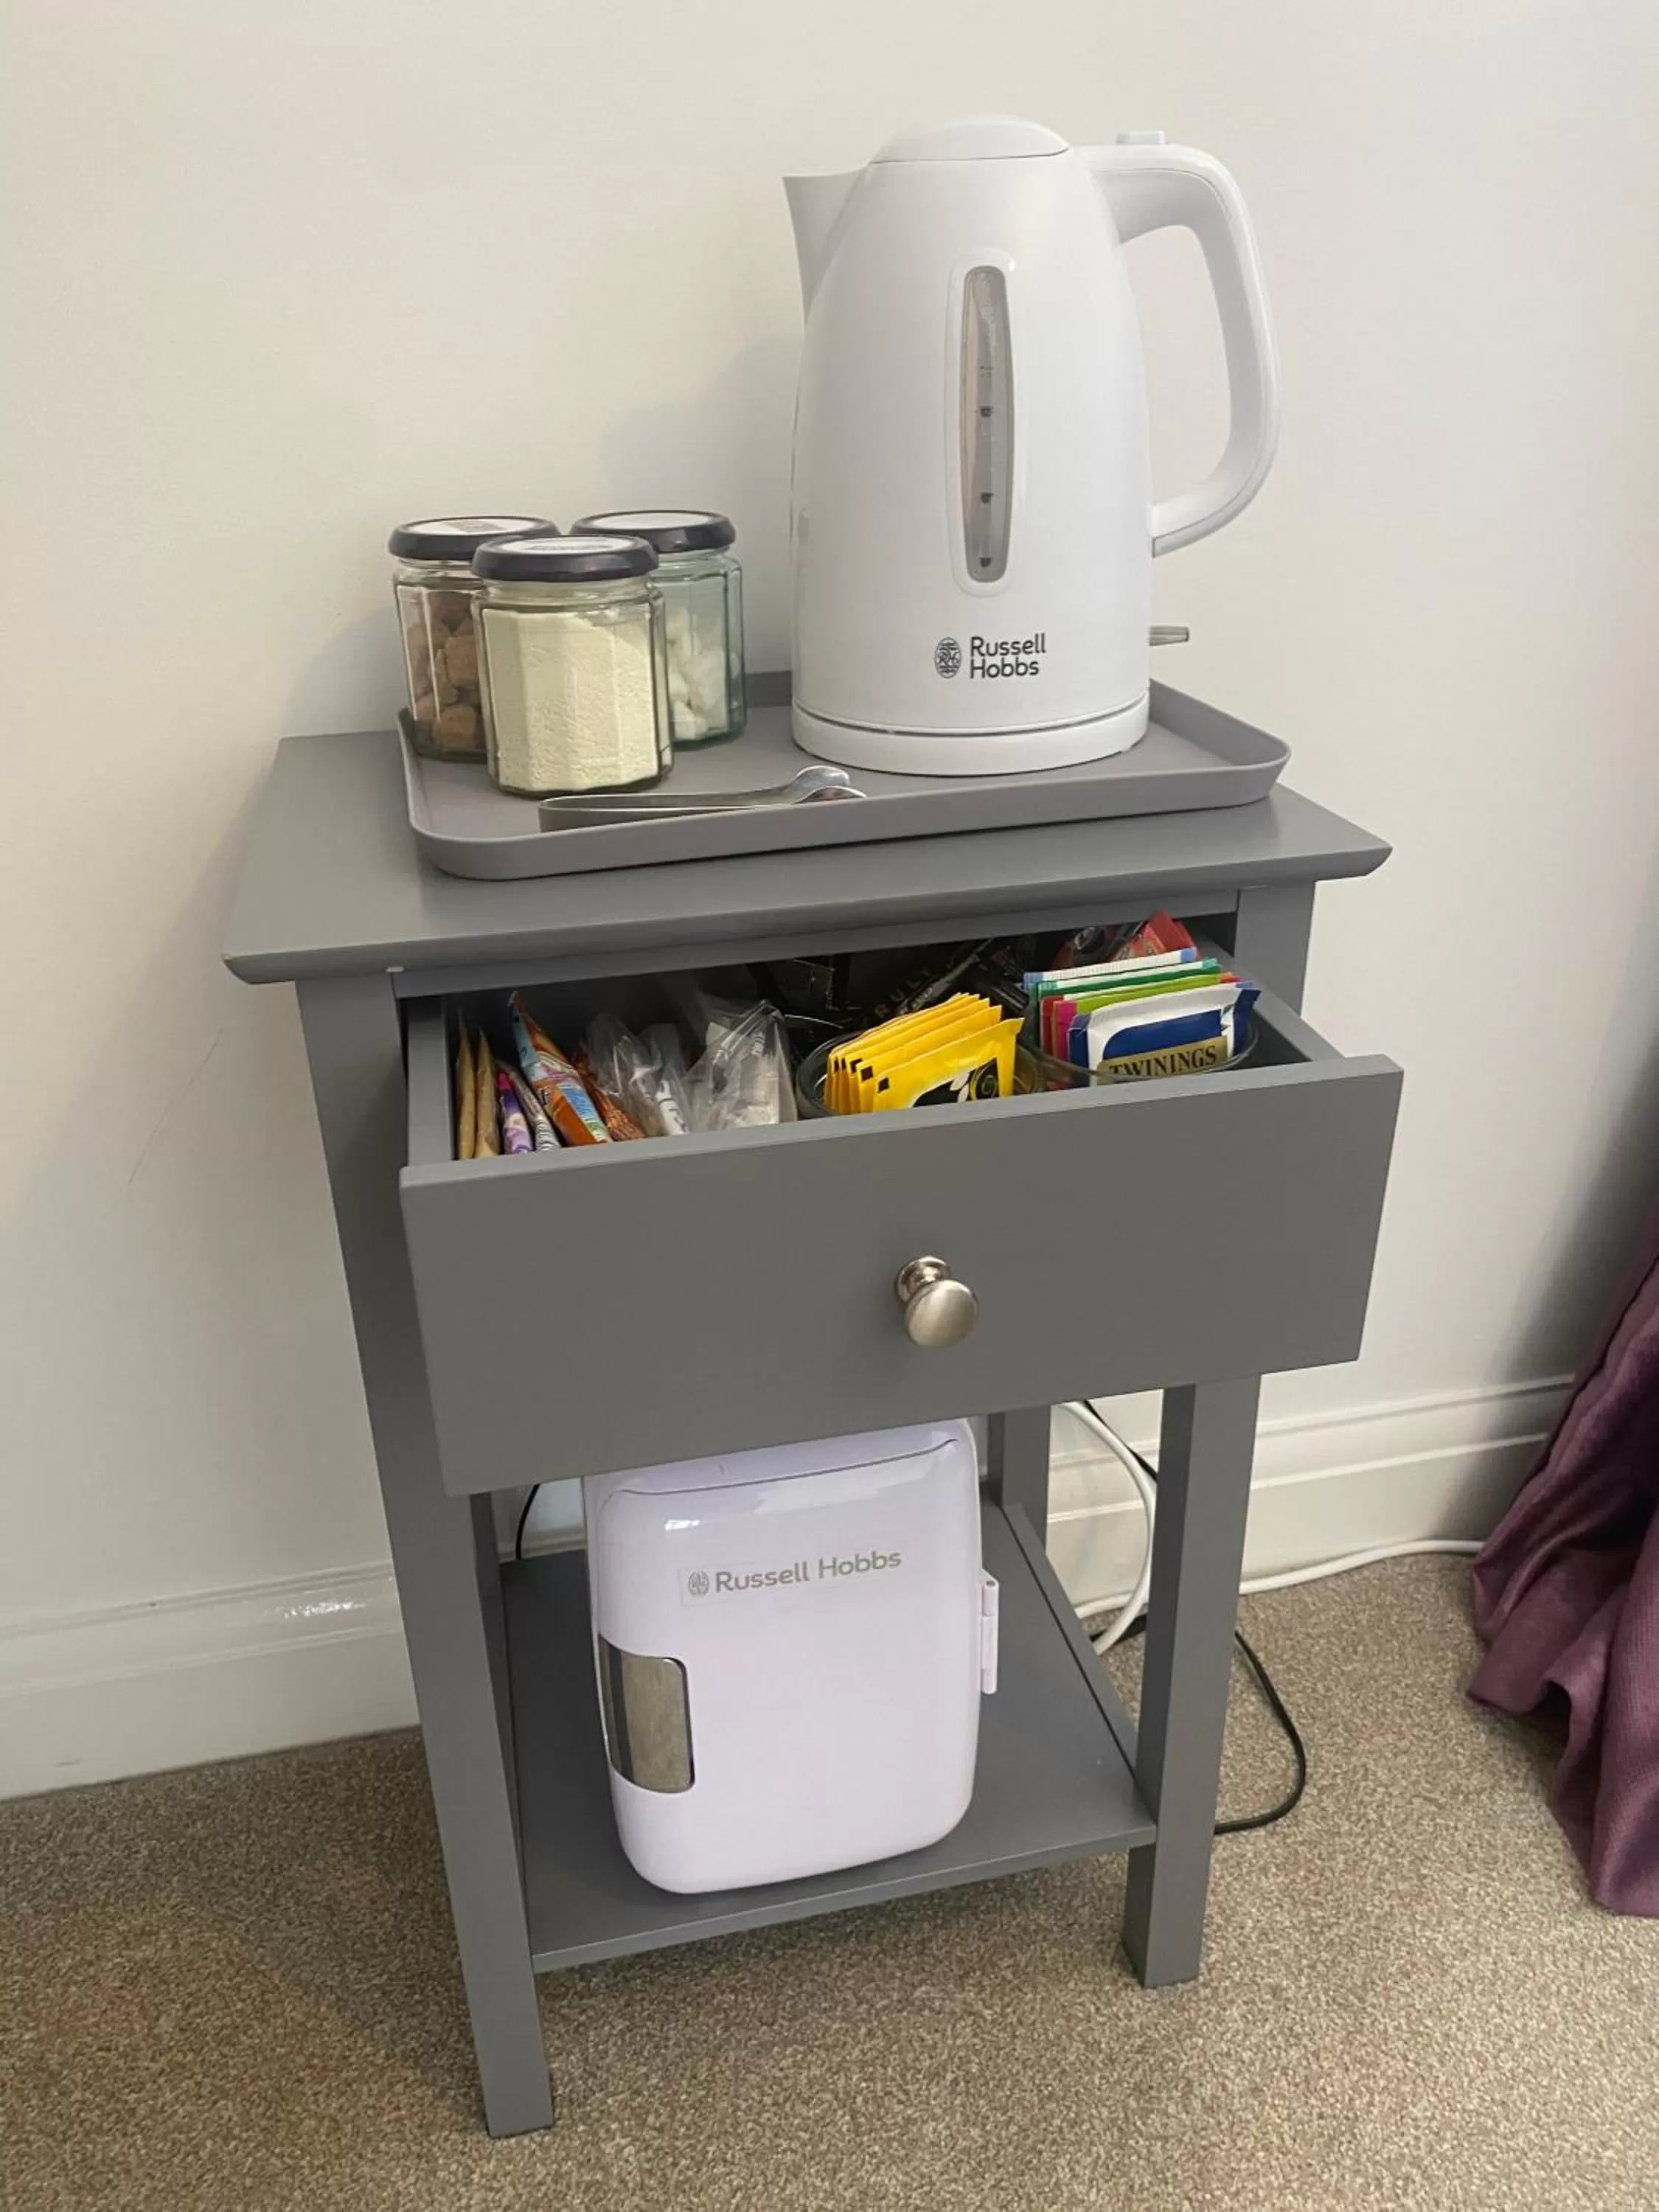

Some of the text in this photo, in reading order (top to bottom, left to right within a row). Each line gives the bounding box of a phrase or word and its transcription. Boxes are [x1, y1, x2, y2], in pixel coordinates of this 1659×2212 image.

[970, 633, 1047, 657] Russell
[970, 656, 1040, 679] Hobbs
[1109, 1045, 1217, 1077] TWININGS
[715, 1550, 902, 1593] Russell Hobbs
